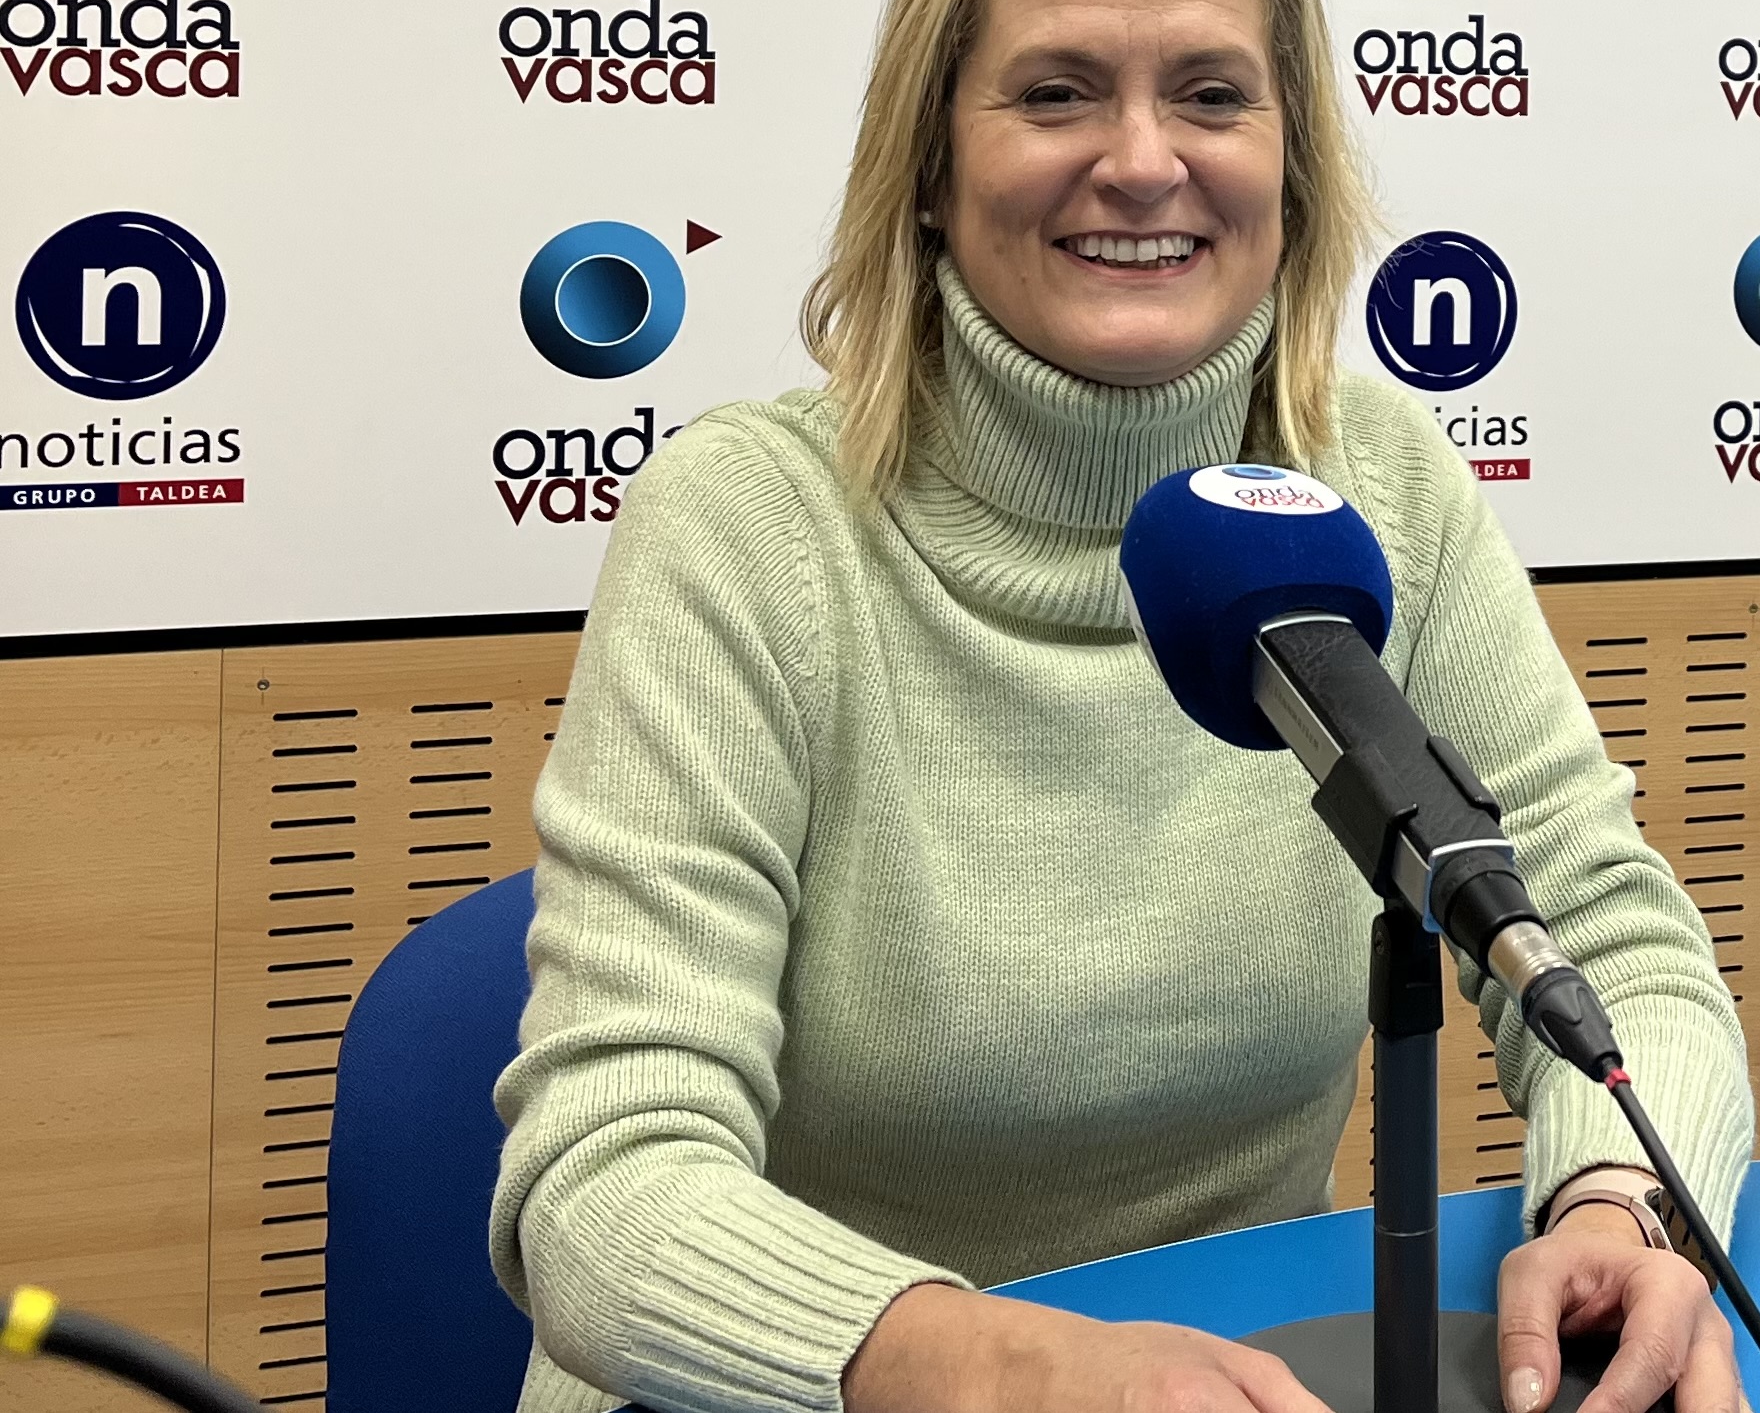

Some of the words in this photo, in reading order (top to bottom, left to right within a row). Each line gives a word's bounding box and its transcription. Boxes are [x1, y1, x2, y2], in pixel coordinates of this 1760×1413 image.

[1353, 15, 1528, 76] onda
[0, 47, 240, 98] vasca
[501, 57, 716, 105] vasca
[1355, 75, 1529, 117] vasca
[0, 417, 241, 468] noticias
[493, 407, 686, 480] ond
[13, 488, 96, 505] GRUPO
[136, 484, 227, 502] TALDEA
[1235, 485, 1315, 499] onda
[1475, 463, 1518, 478] LDEA
[495, 476, 621, 527] vas
